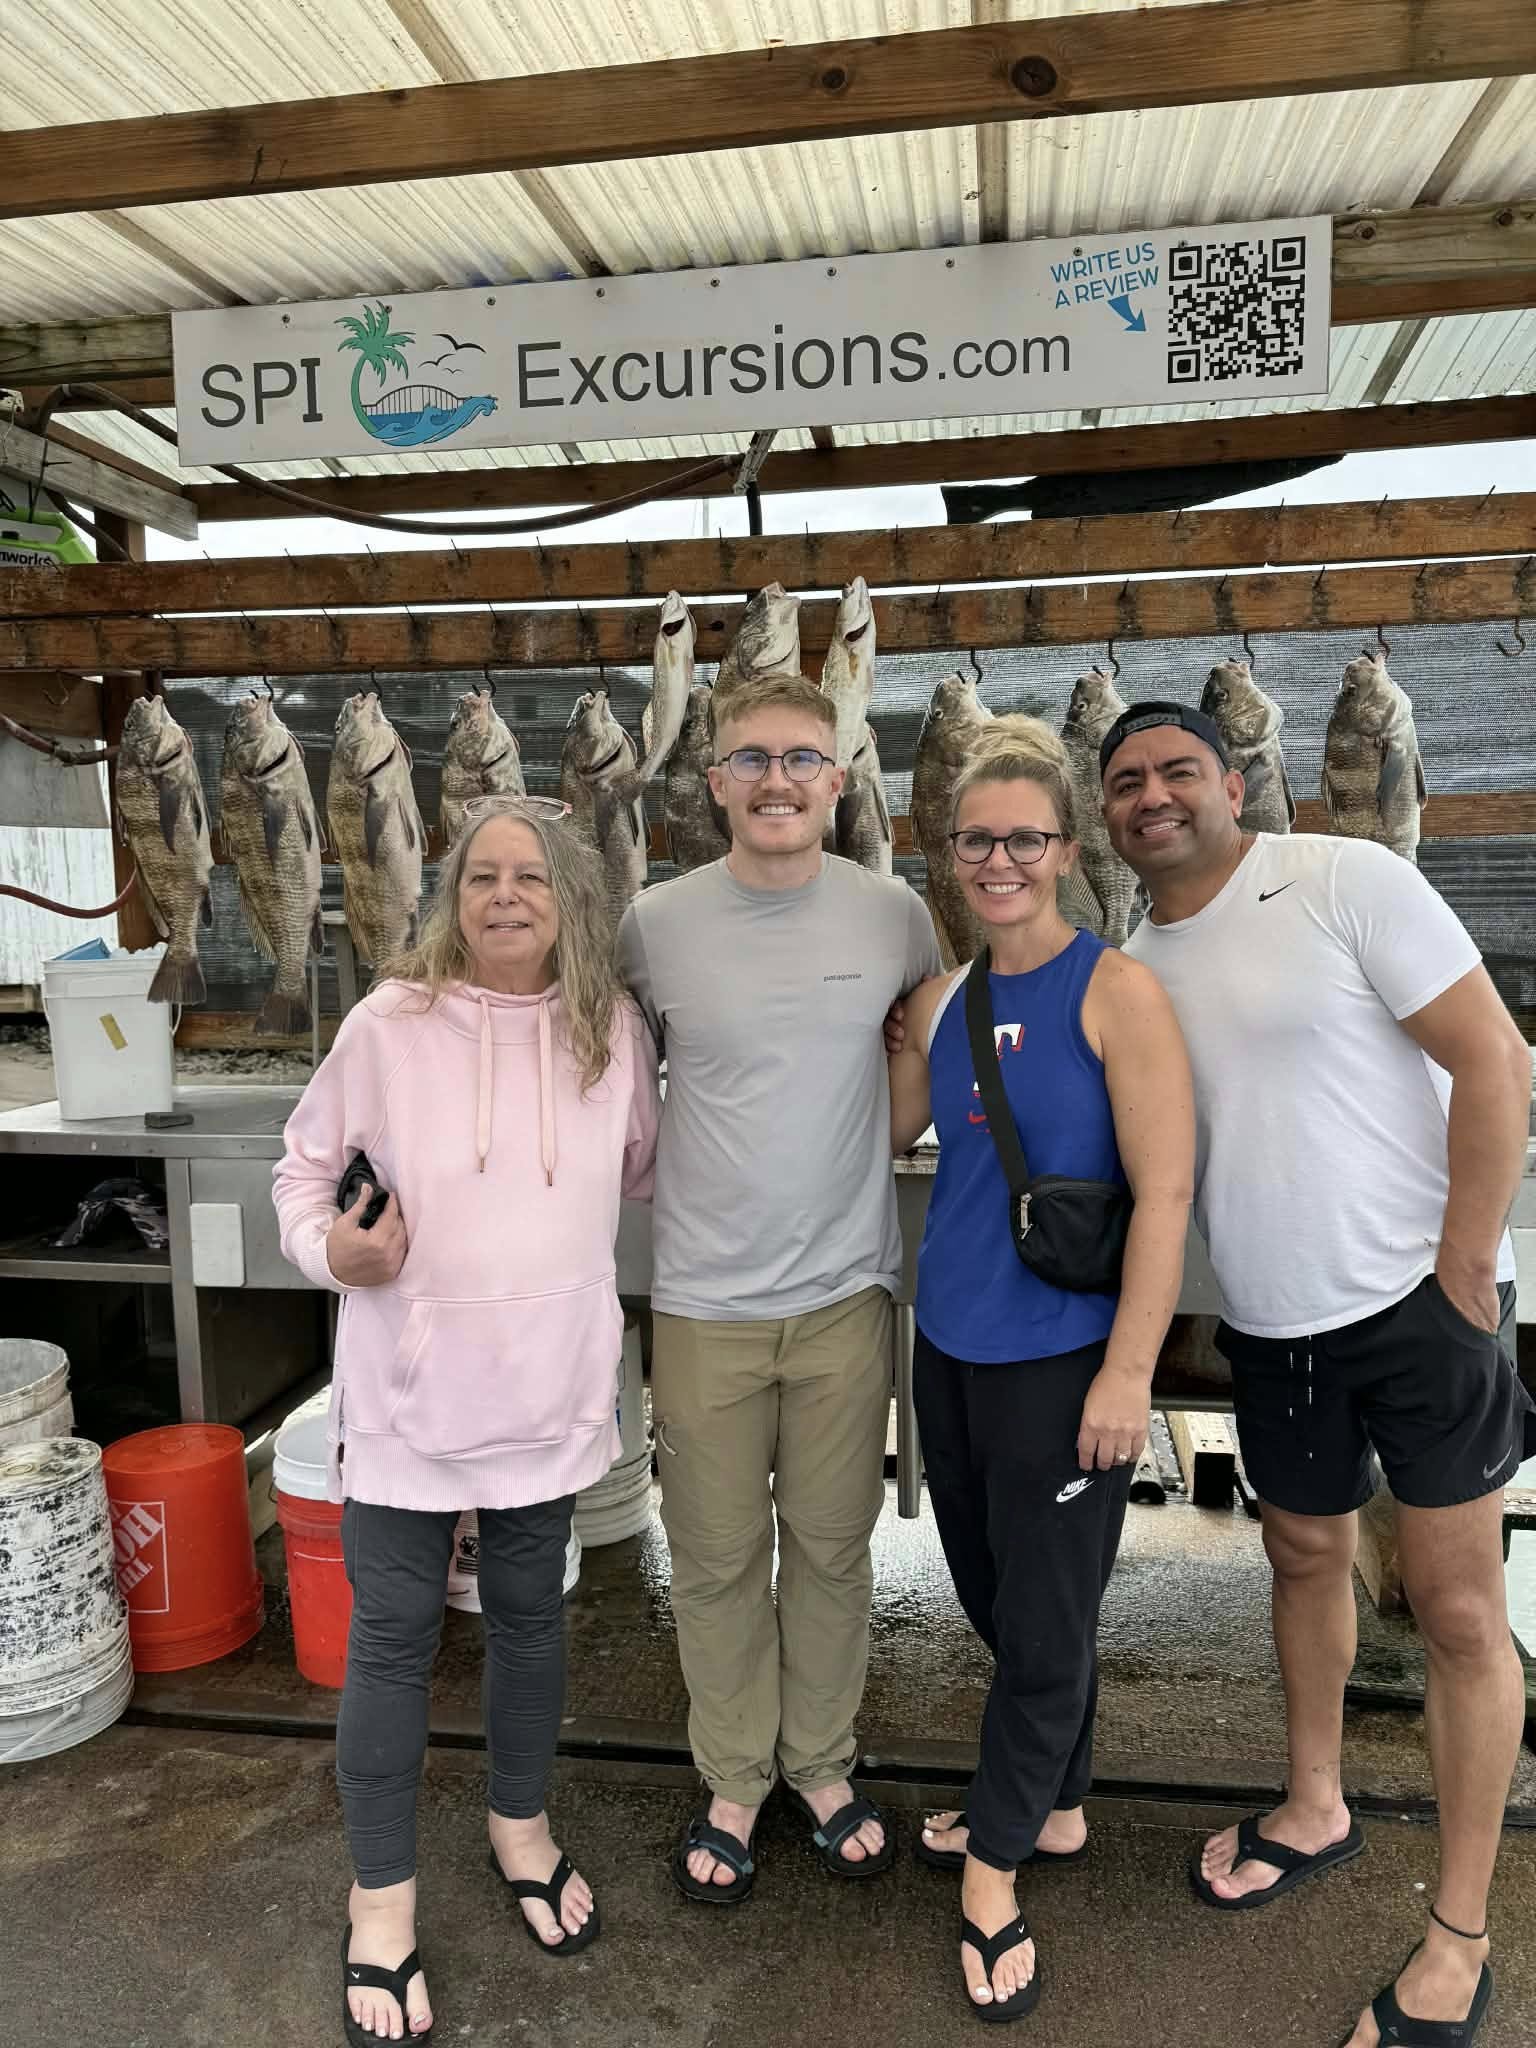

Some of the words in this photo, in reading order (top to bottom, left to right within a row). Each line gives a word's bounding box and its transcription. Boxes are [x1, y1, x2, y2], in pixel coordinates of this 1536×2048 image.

[1050, 250, 1122, 283] WRITE
[1126, 242, 1155, 265] US
[1055, 289, 1071, 309] A
[1074, 266, 1159, 304] REVIEW
[201, 357, 323, 428] SPI
[517, 325, 1071, 408] Excursions.com
[1062, 1477, 1089, 1495] NIKE
